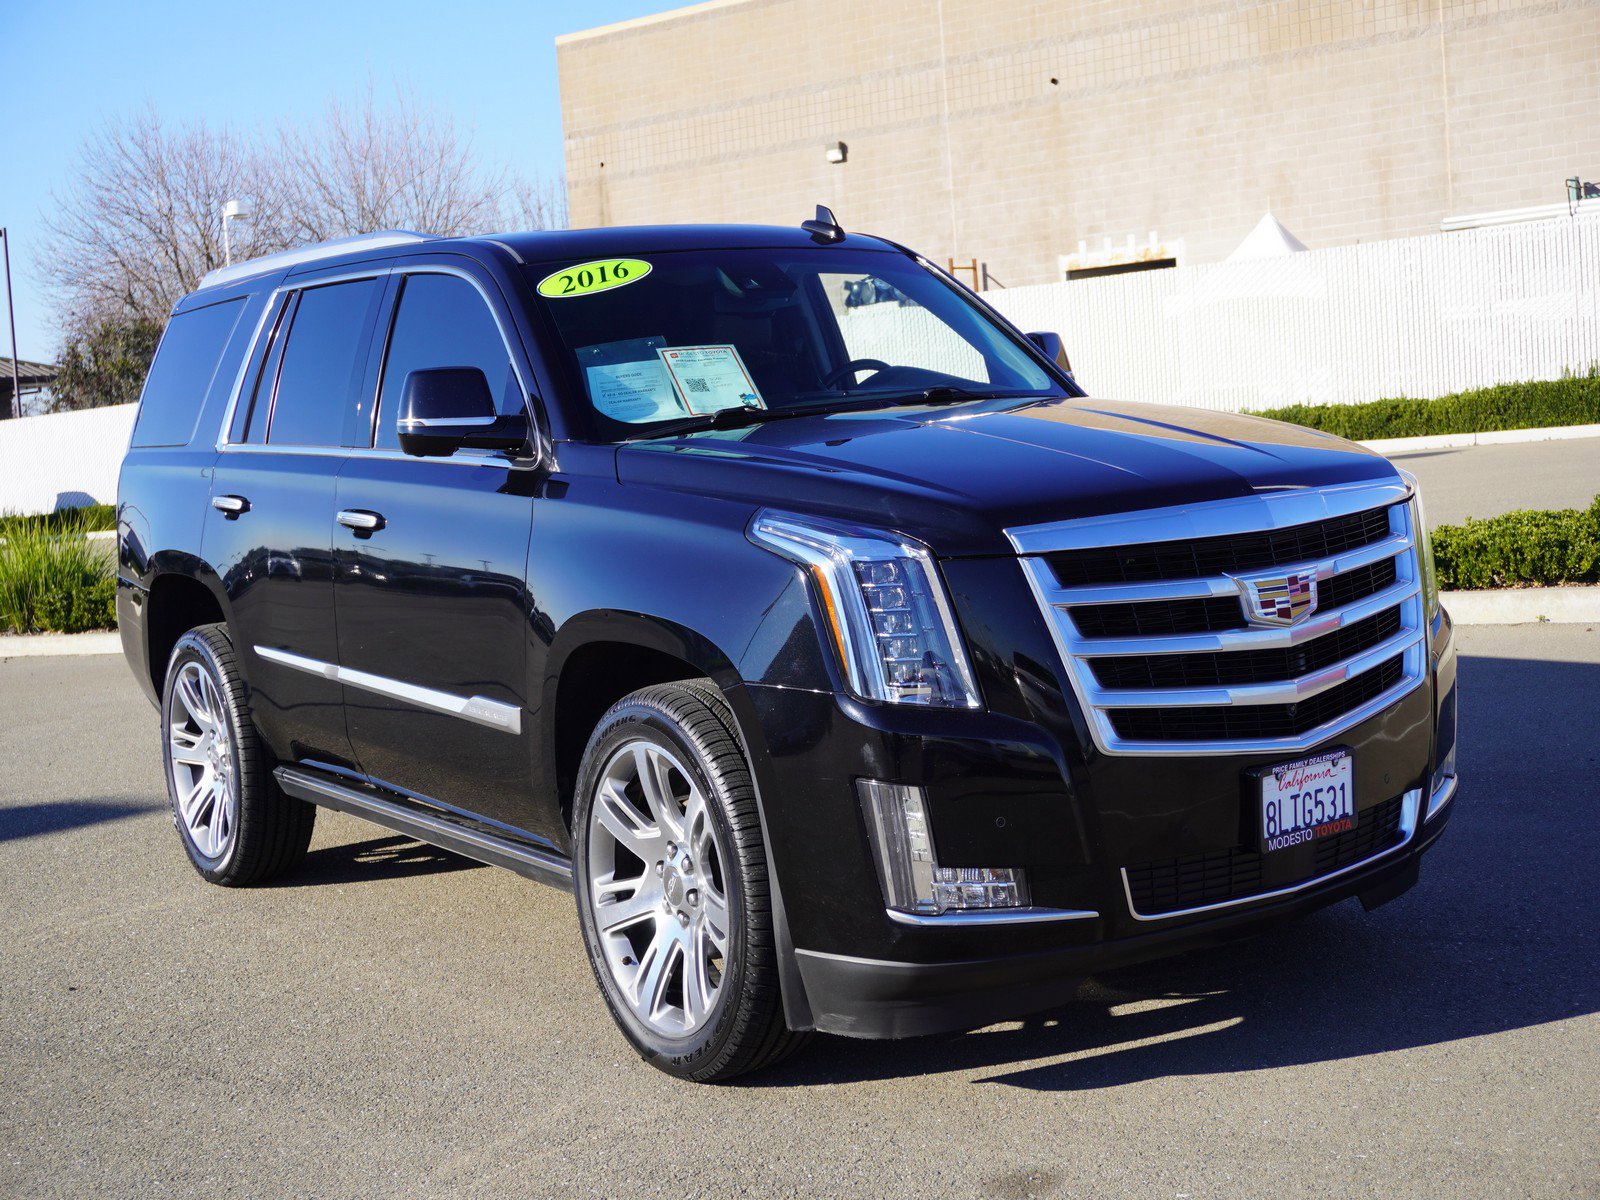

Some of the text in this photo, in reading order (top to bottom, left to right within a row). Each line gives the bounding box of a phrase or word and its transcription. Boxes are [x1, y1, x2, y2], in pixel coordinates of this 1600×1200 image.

[558, 261, 629, 294] 2016
[1289, 760, 1308, 770] FAMILY
[1309, 751, 1346, 765] DEALERSHIPS
[1278, 768, 1338, 791] California
[1266, 782, 1350, 838] 8LIG531
[1268, 819, 1352, 851] MODESTO TOYOTA
